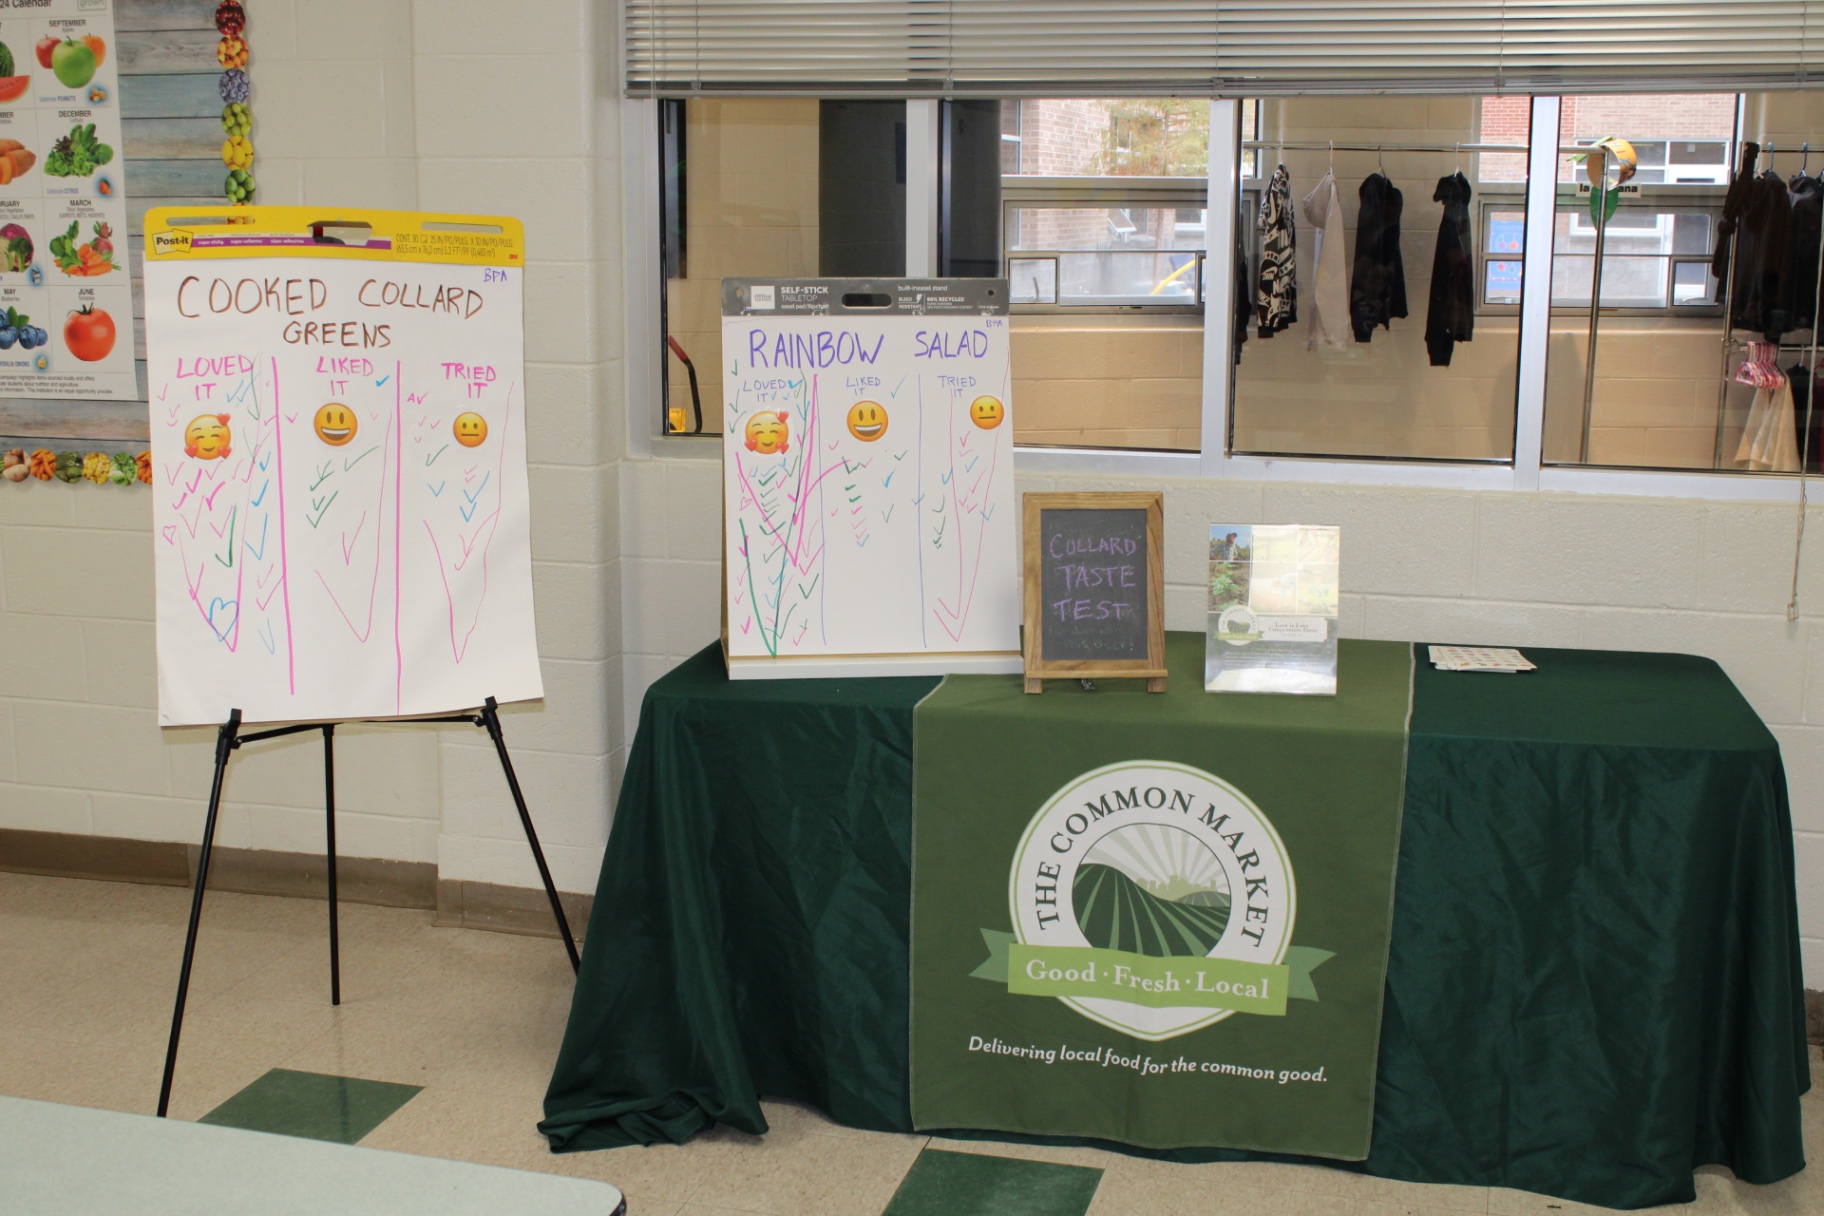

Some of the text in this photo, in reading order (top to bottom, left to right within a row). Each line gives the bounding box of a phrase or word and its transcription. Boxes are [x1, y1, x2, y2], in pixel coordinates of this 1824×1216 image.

[12, 0, 52, 8] Calendar
[49, 19, 87, 27] SEPTEMBER
[1580, 183, 1590, 192] la
[156, 236, 189, 246] Post-it
[412, 234, 419, 243] 30
[177, 275, 484, 320] COOKED COLLARD
[780, 286, 829, 294] SELF-STICK
[781, 294, 818, 302] TABLETOP
[283, 320, 391, 349] GREENS
[750, 329, 988, 369] RAINBOW SALAD
[177, 354, 253, 380] LOVED
[315, 356, 374, 376] LIKED
[440, 362, 496, 382] TRIED
[330, 380, 349, 397] IT
[742, 379, 787, 392] LOVED
[846, 376, 881, 388] LIKED
[937, 375, 977, 388] TRIED
[194, 383, 217, 400] IT
[467, 382, 487, 399] IT
[757, 393, 768, 402] IT
[854, 387, 865, 396] IT
[953, 388, 964, 398] IT
[1049, 533, 1137, 560] COLLARD
[1058, 564, 1136, 594] TASTE
[1053, 598, 1131, 622] TEST
[1035, 786, 1269, 948] THE COMMON MARKET
[1025, 958, 1269, 999] Good Fresh Local
[968, 1035, 1328, 1085] Delivering local food for the common good.
